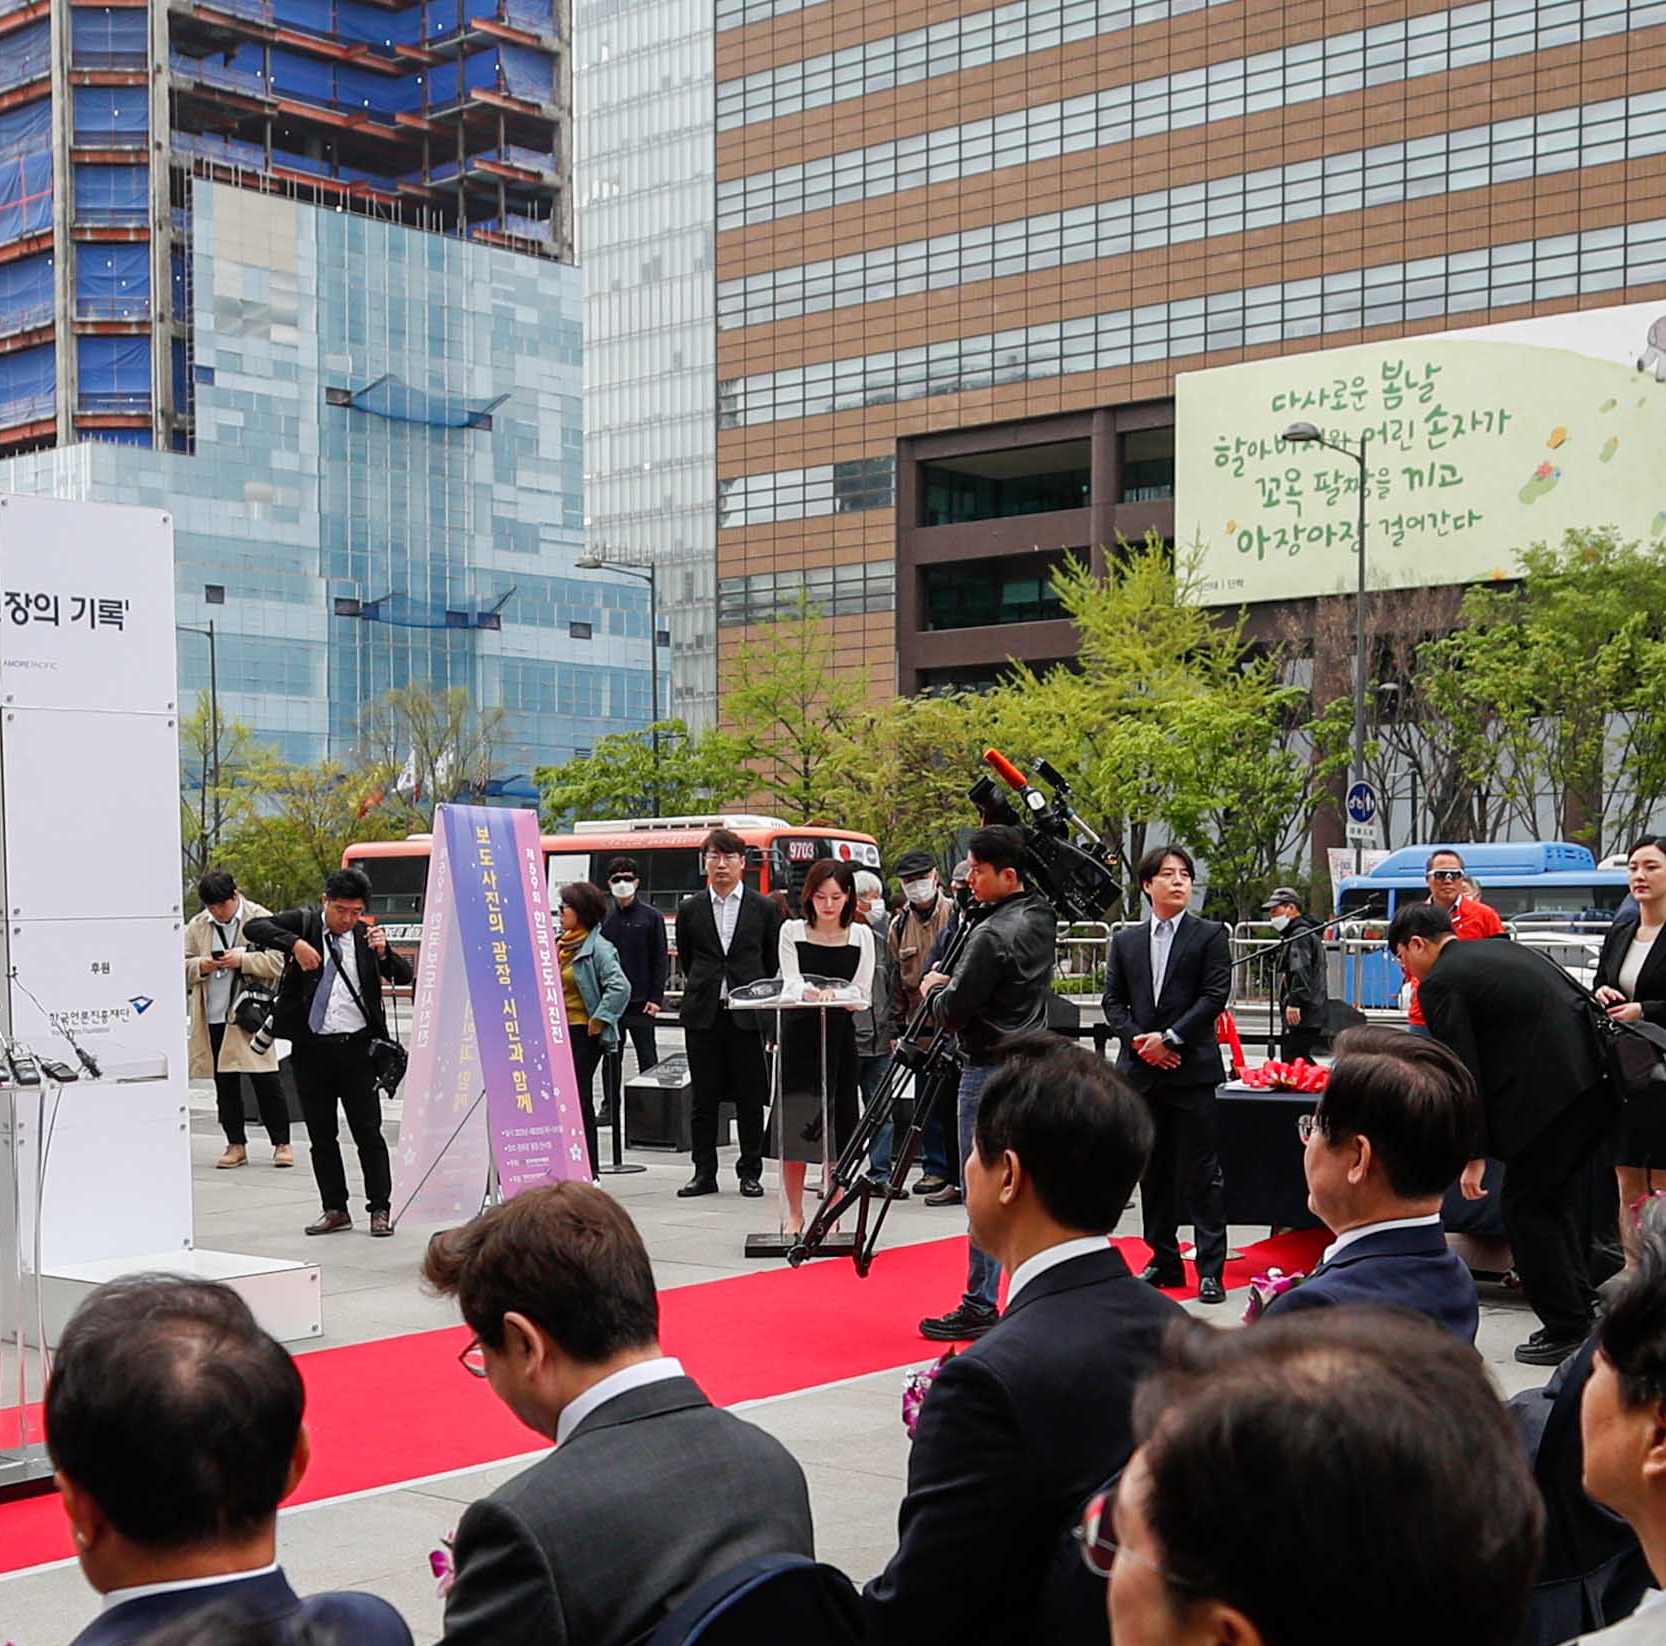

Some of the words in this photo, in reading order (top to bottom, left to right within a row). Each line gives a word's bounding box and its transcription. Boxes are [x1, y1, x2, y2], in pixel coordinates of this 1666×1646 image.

[1271, 376, 1369, 412] 다사로운
[1381, 360, 1442, 410] 봄날
[1362, 419, 1414, 452] 어린
[1424, 404, 1512, 450] 손자가
[1255, 468, 1303, 518] 꼬옥
[1314, 467, 1391, 507] 팔짱을
[1401, 461, 1464, 491] 끼고
[1237, 520, 1370, 561] 아장아장
[1379, 509, 1483, 547] 걸어간다
[70, 597, 130, 631] 기록'
[789, 841, 814, 859] 9703
[476, 826, 505, 934] 보도사진의
[90, 961, 110, 975] 후원
[525, 848, 541, 904] 제59회
[534, 911, 564, 1045] 한국보도사진전
[49, 1007, 130, 1027] 한국언론진흥재단
[503, 998, 524, 1064] 시민과
[512, 1070, 533, 1115] 함께
